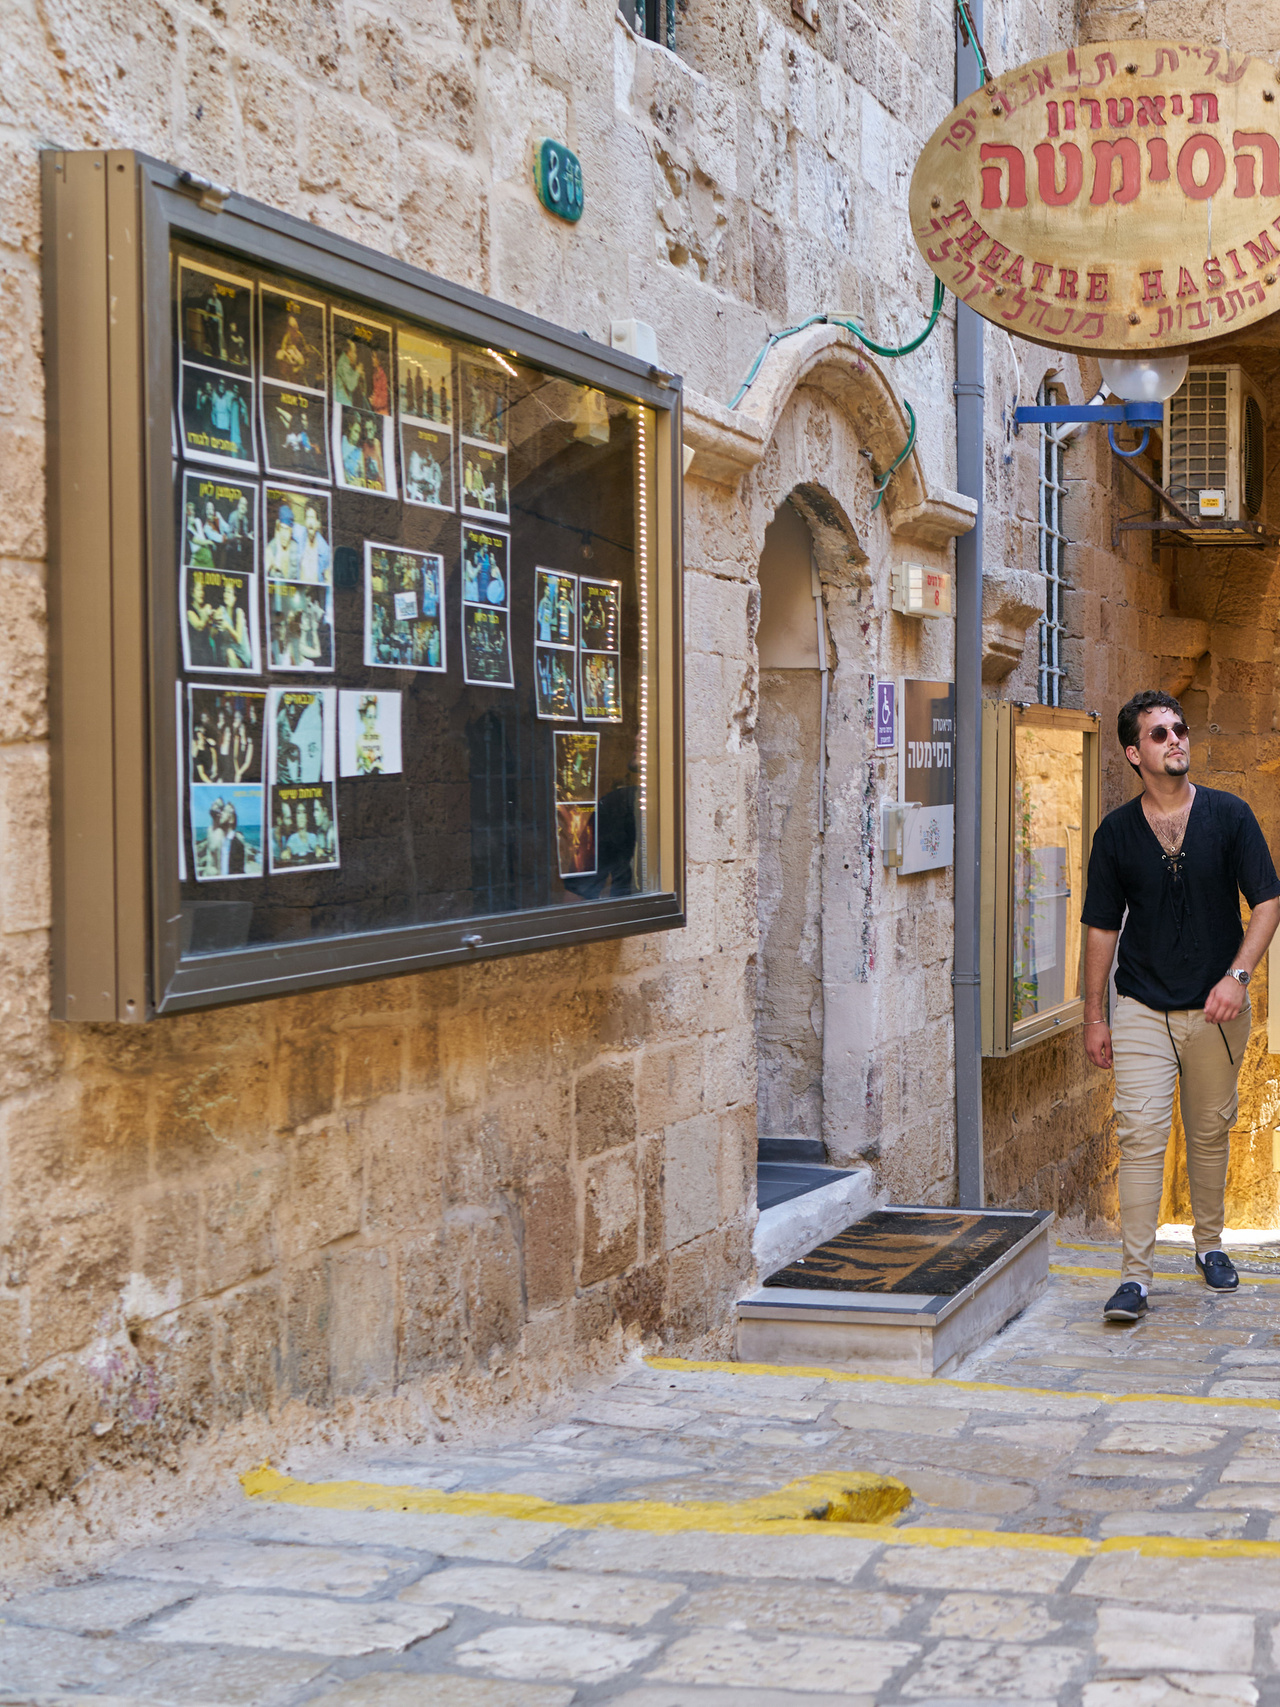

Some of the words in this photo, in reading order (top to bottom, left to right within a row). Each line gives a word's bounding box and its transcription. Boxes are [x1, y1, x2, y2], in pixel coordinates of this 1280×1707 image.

[991, 64, 1055, 122] אביב
[1060, 48, 1118, 93] תל
[941, 106, 977, 152] יפו
[1046, 92, 1219, 138] תיאטרון
[548, 149, 561, 202] 8
[941, 200, 1108, 302] THEATRE
[1001, 287, 1107, 339] מנהל
[1149, 280, 1266, 338] התרבות
[934, 590, 940, 606] 8
[908, 741, 951, 769] הסימטה
